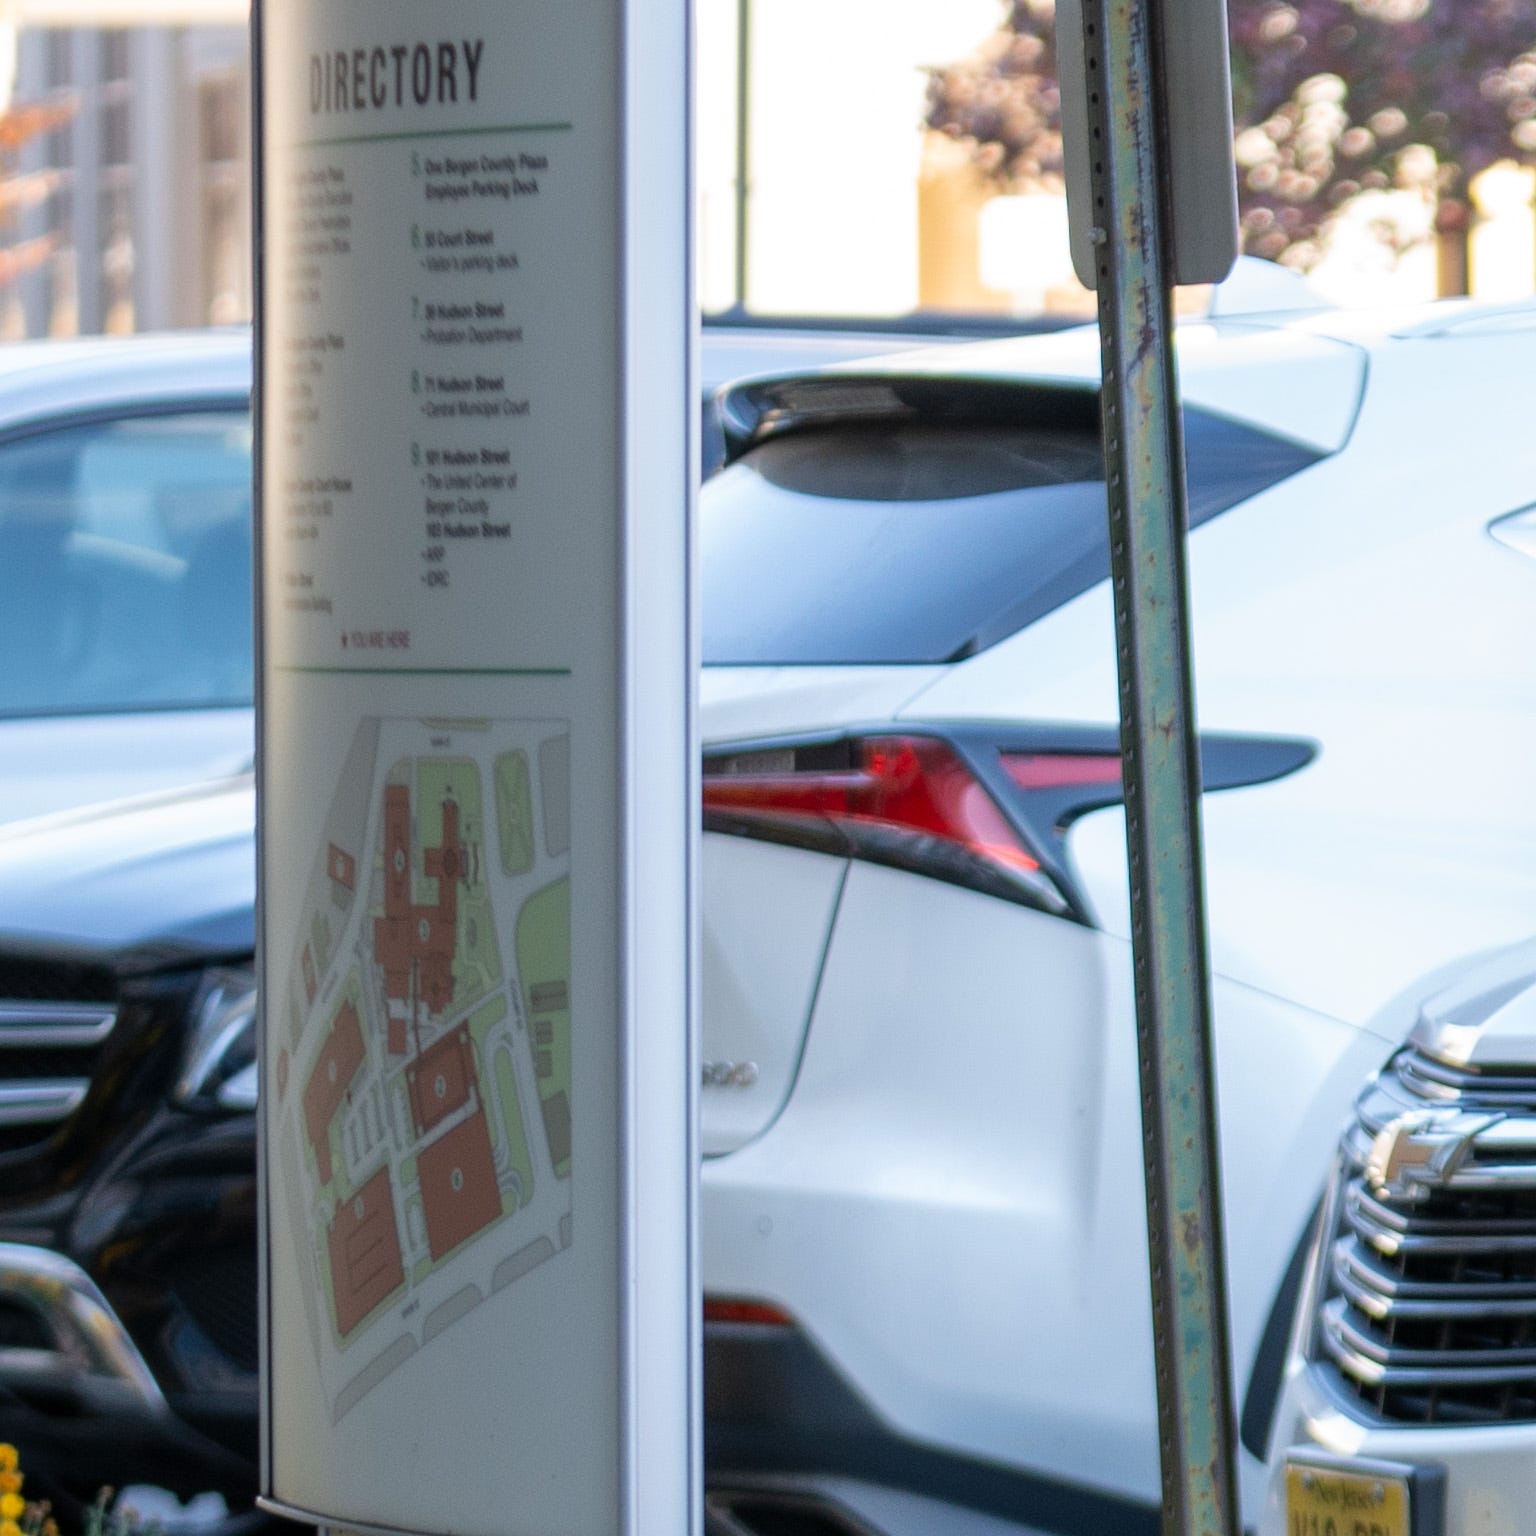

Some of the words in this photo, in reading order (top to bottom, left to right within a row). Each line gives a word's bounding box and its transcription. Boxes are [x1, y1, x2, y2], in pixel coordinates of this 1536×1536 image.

[310, 38, 485, 116] DIRECTORY
[445, 158, 478, 177] Bergen
[481, 155, 516, 174] County
[519, 153, 548, 169] Plaza
[472, 180, 509, 199] Parking
[512, 177, 539, 194] Deck
[438, 231, 462, 247] Court
[465, 229, 494, 245] Street
[438, 304, 472, 319] Hudson
[475, 302, 504, 317] Street
[468, 327, 523, 343] Department
[437, 377, 472, 391] Hudson
[475, 376, 504, 391] Street
[458, 401, 499, 417] Municipal
[503, 399, 530, 415] Court
[442, 450, 478, 465] Hudson
[481, 449, 510, 464] Street
[426, 498, 456, 515] Bergen
[458, 498, 489, 515] County
